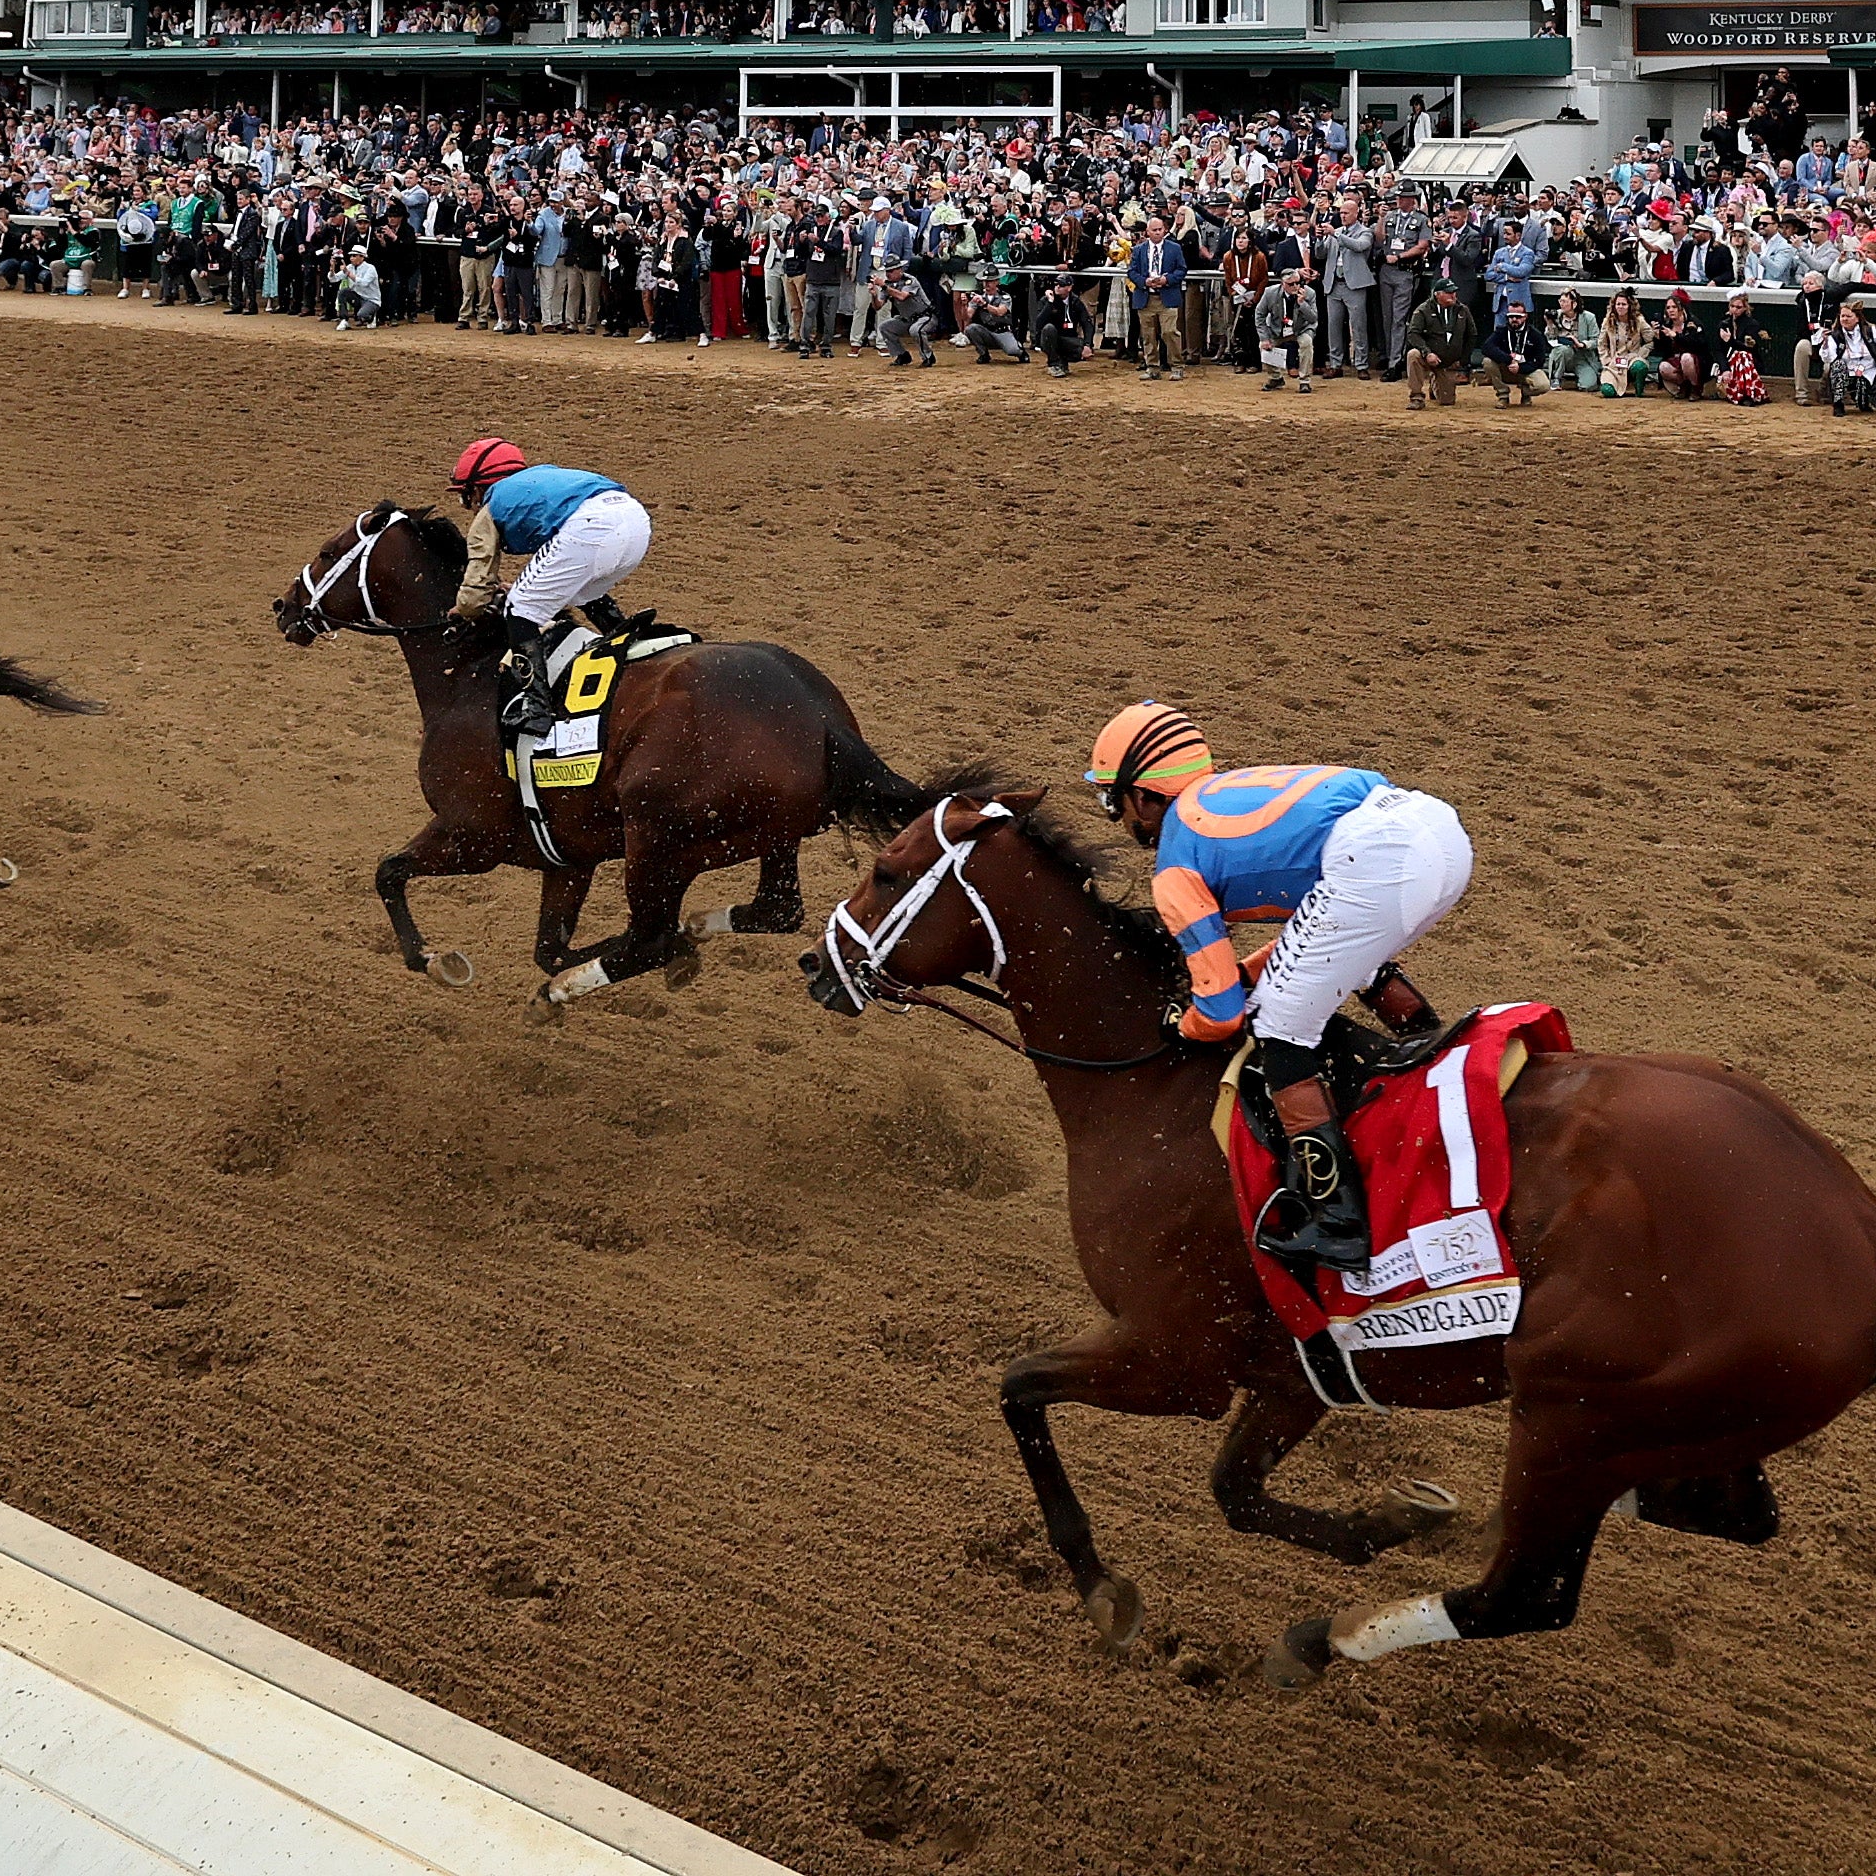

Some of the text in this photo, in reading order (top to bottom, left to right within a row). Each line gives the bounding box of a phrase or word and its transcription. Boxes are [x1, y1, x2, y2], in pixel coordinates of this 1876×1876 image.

[1666, 31, 1876, 46] WOODFORD RESERVE
[1709, 10, 1834, 27] KENTUCKY DERBY
[564, 648, 617, 714] 6
[1426, 1044, 1480, 1208] 1
[1439, 1231, 1479, 1262] 152
[1354, 1291, 1510, 1340] RENEGADE
